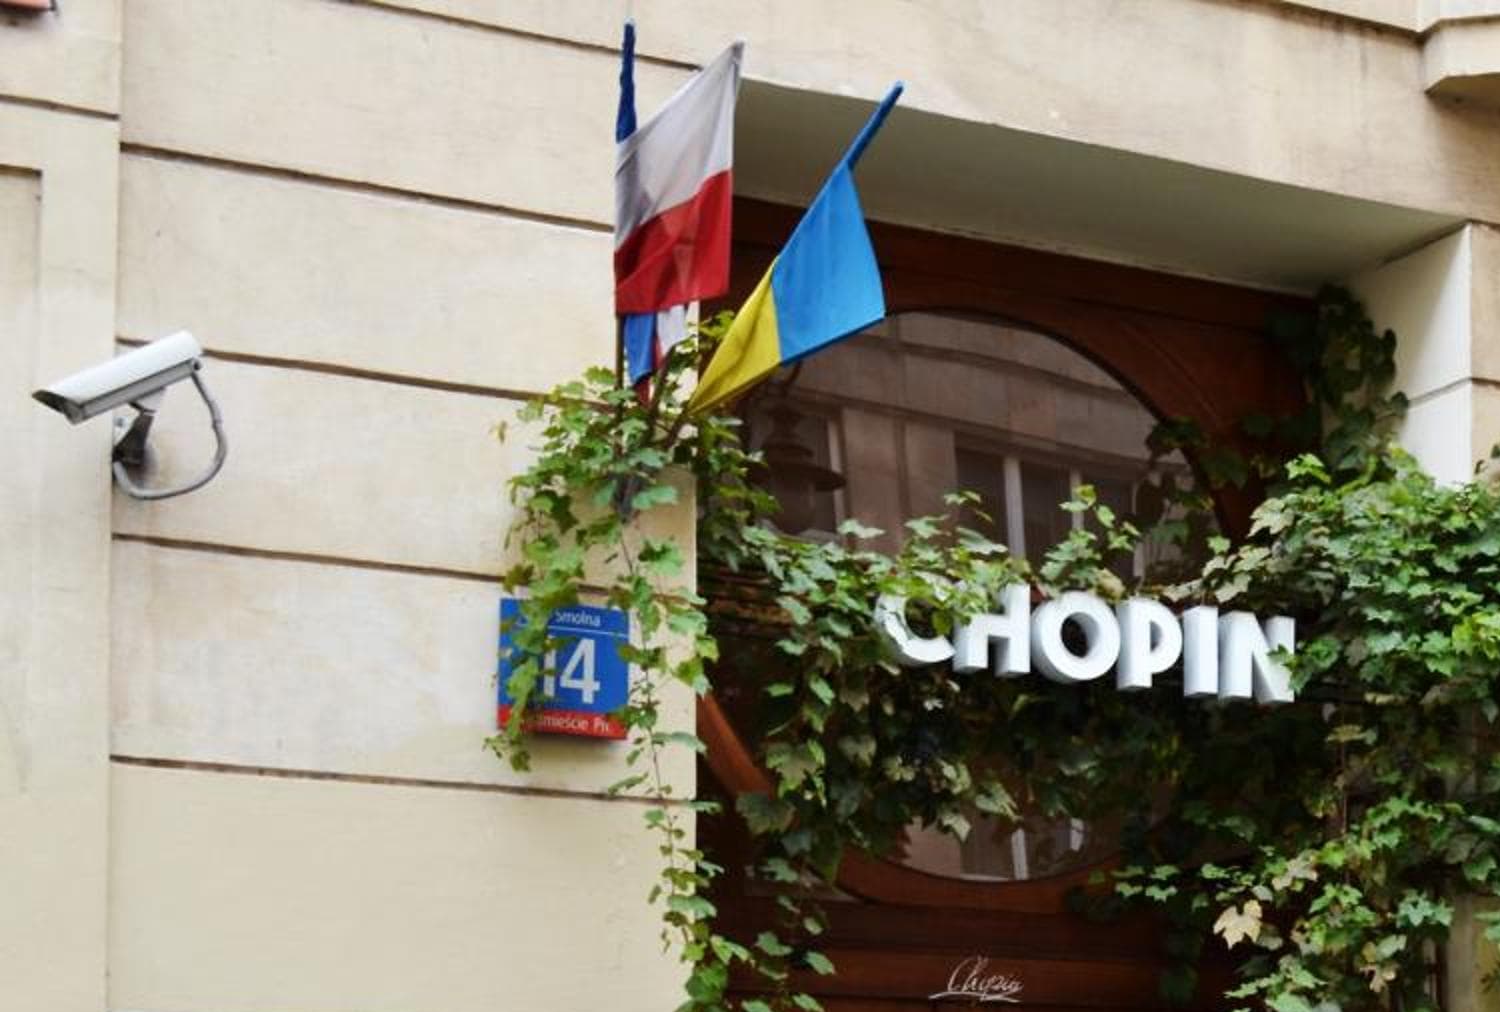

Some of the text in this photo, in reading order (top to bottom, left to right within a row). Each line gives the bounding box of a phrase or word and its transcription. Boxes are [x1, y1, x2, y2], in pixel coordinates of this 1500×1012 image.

[554, 610, 601, 627] Smolna
[875, 580, 1296, 703] CHOPIN
[543, 634, 601, 705] 14
